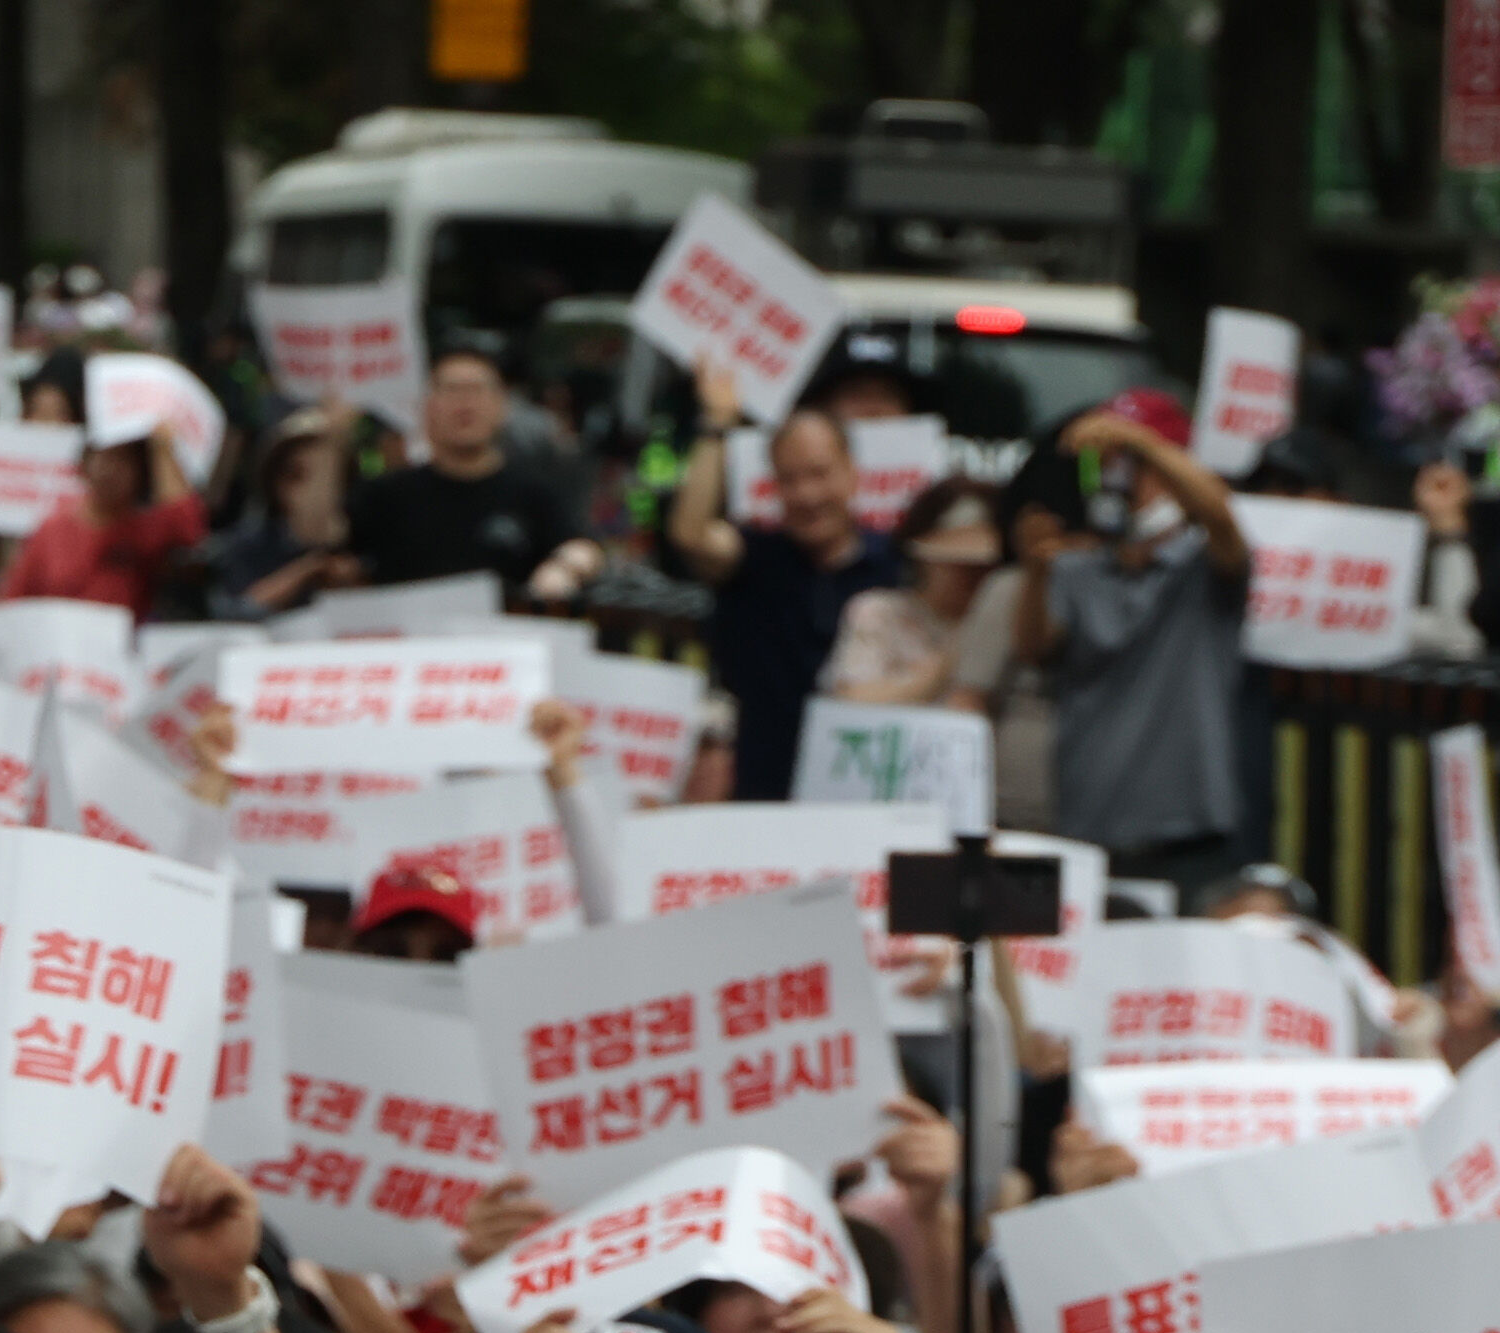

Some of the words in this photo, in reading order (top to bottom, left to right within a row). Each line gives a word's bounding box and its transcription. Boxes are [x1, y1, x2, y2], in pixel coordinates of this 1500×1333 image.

[31, 932, 172, 1021] 침해
[528, 997, 699, 1077] 참정권
[720, 965, 828, 1038] 침해
[14, 1017, 178, 1113] 실시!
[531, 1071, 701, 1151] 재선거
[725, 1034, 852, 1114] 실시!
[378, 1098, 498, 1161] 박탈한
[374, 1166, 494, 1229] 해체
